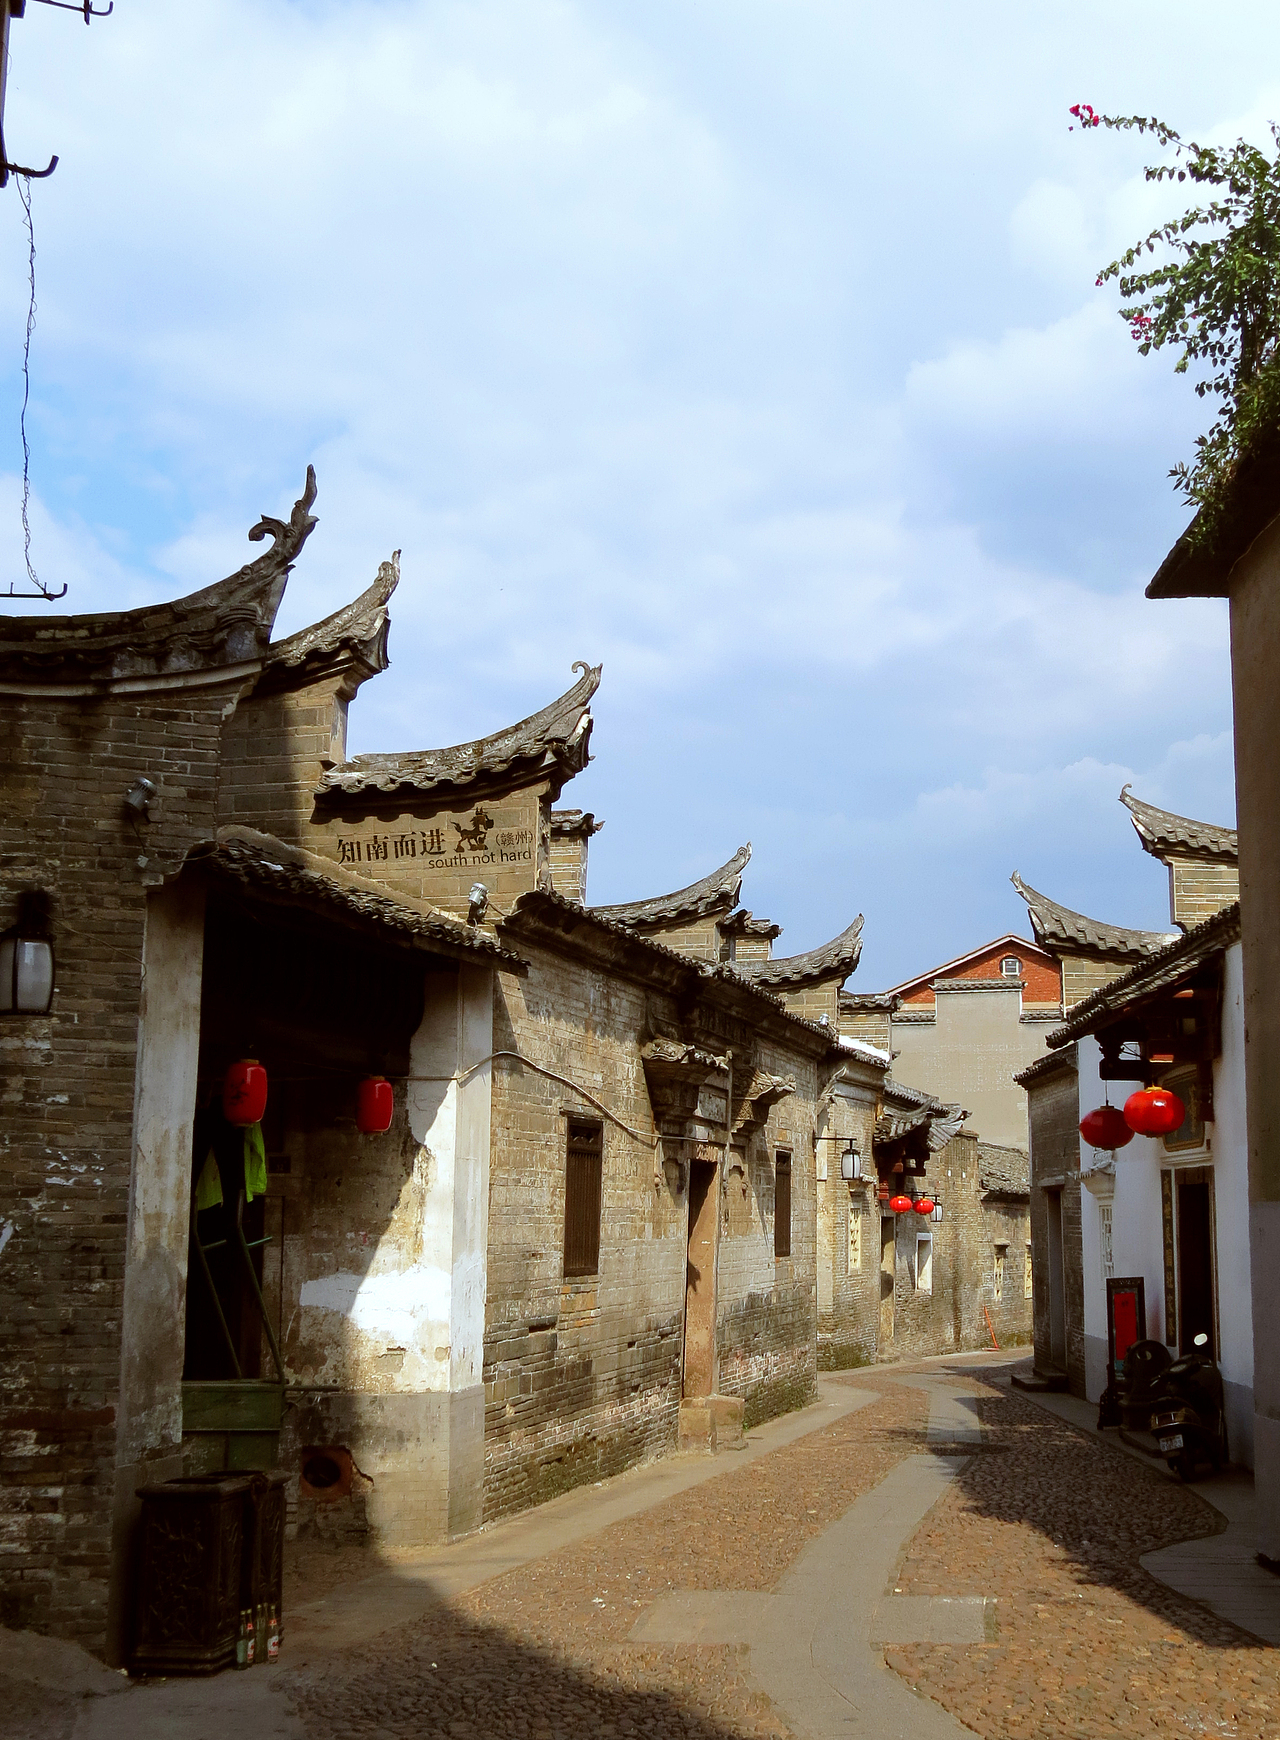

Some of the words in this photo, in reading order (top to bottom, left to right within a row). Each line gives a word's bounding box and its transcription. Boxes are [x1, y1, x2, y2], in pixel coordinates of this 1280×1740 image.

[336, 828, 447, 866] 知南而进
[428, 854, 467, 870] south
[472, 851, 496, 865] not
[500, 846, 532, 862] hard
